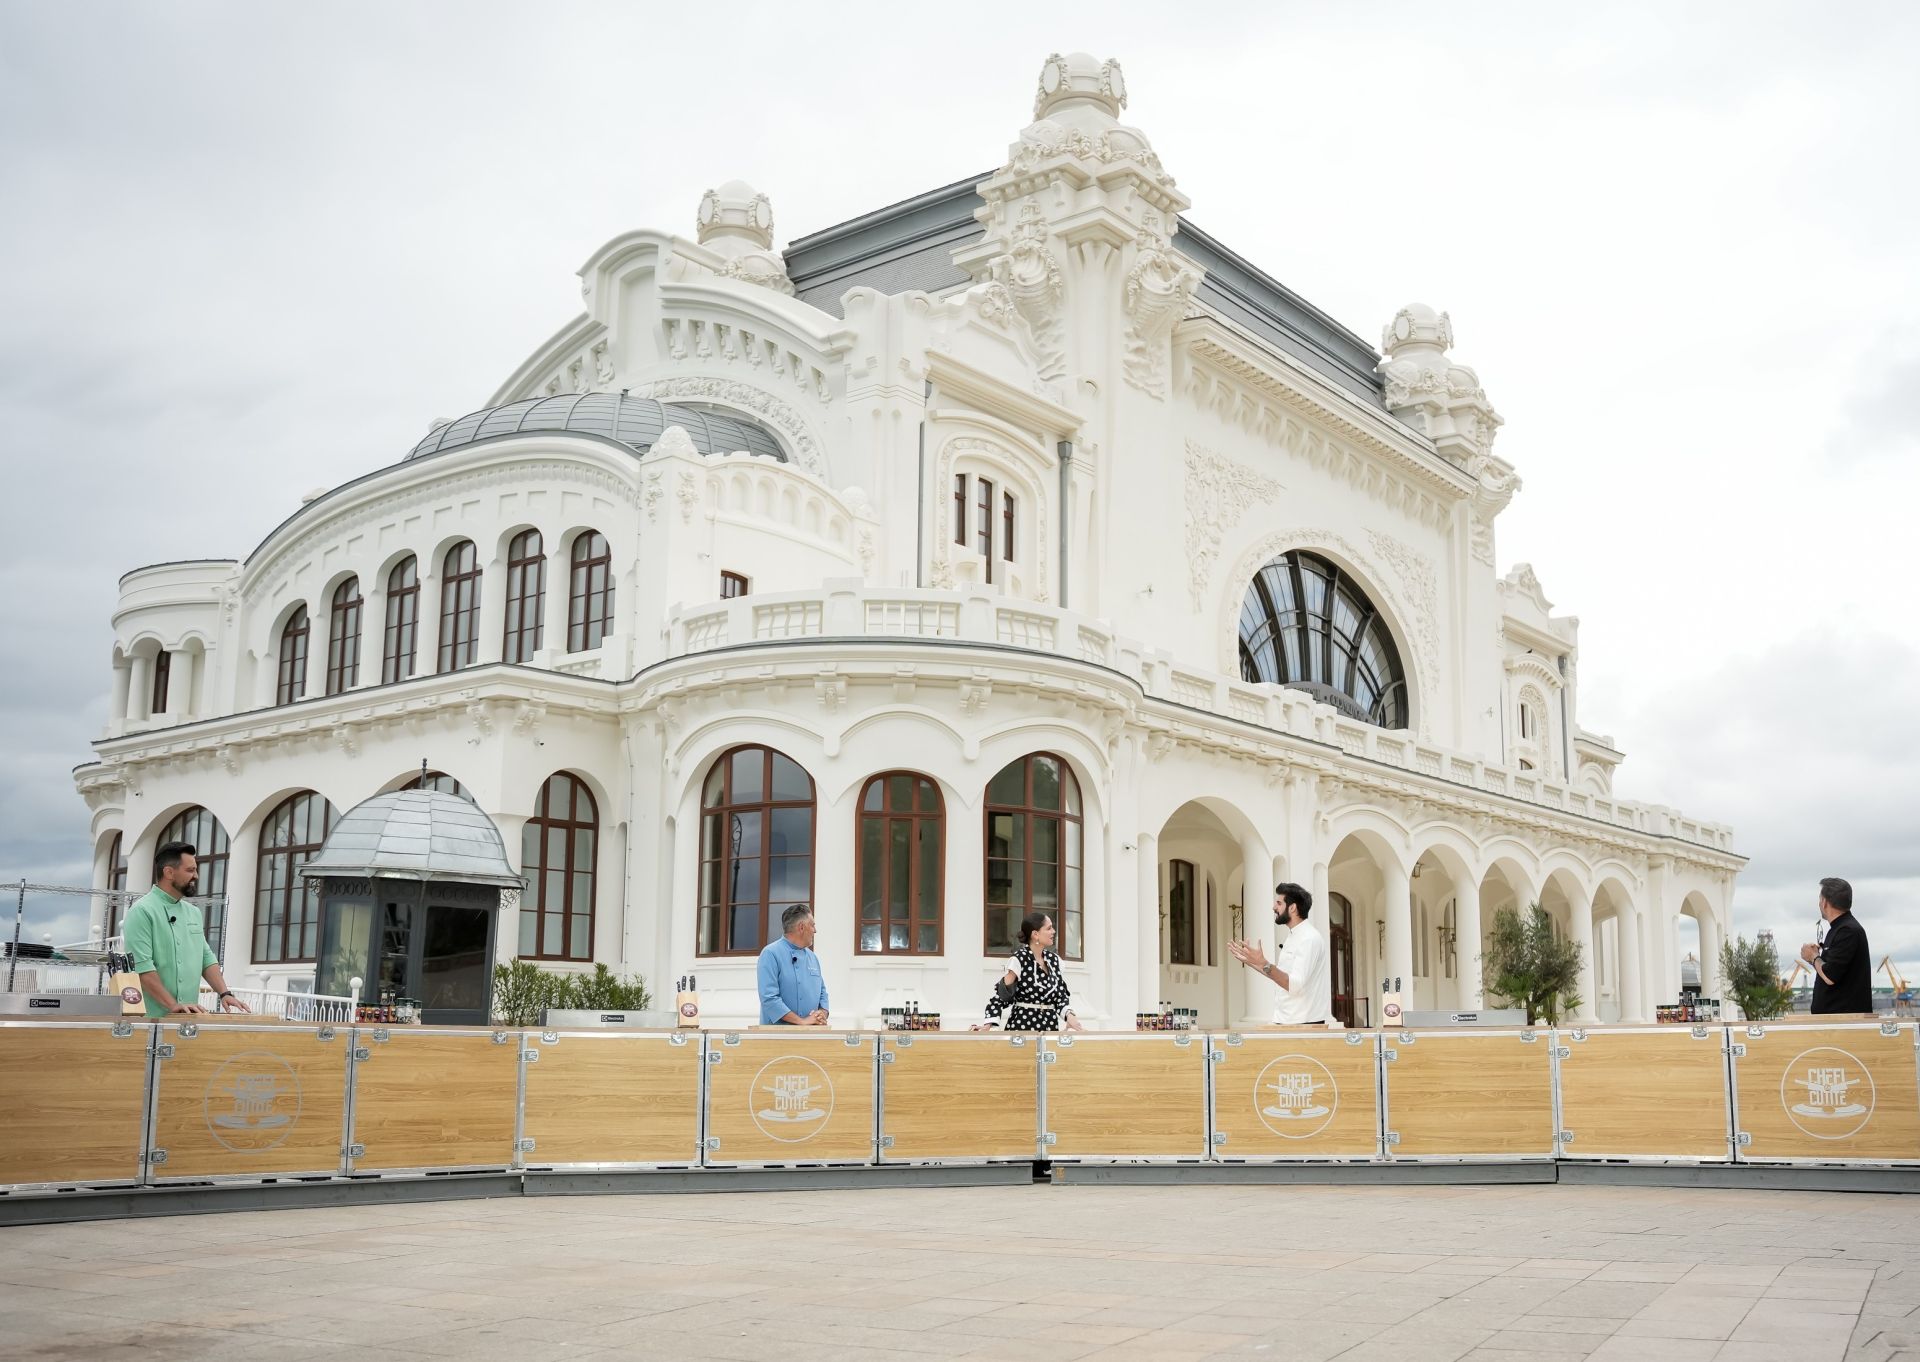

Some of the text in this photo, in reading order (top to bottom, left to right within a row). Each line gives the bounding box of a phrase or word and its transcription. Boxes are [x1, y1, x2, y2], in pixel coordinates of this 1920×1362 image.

[775, 1075, 809, 1091] CHEFI
[1278, 1073, 1312, 1089] CHEFI
[1807, 1067, 1846, 1085] CHEFI
